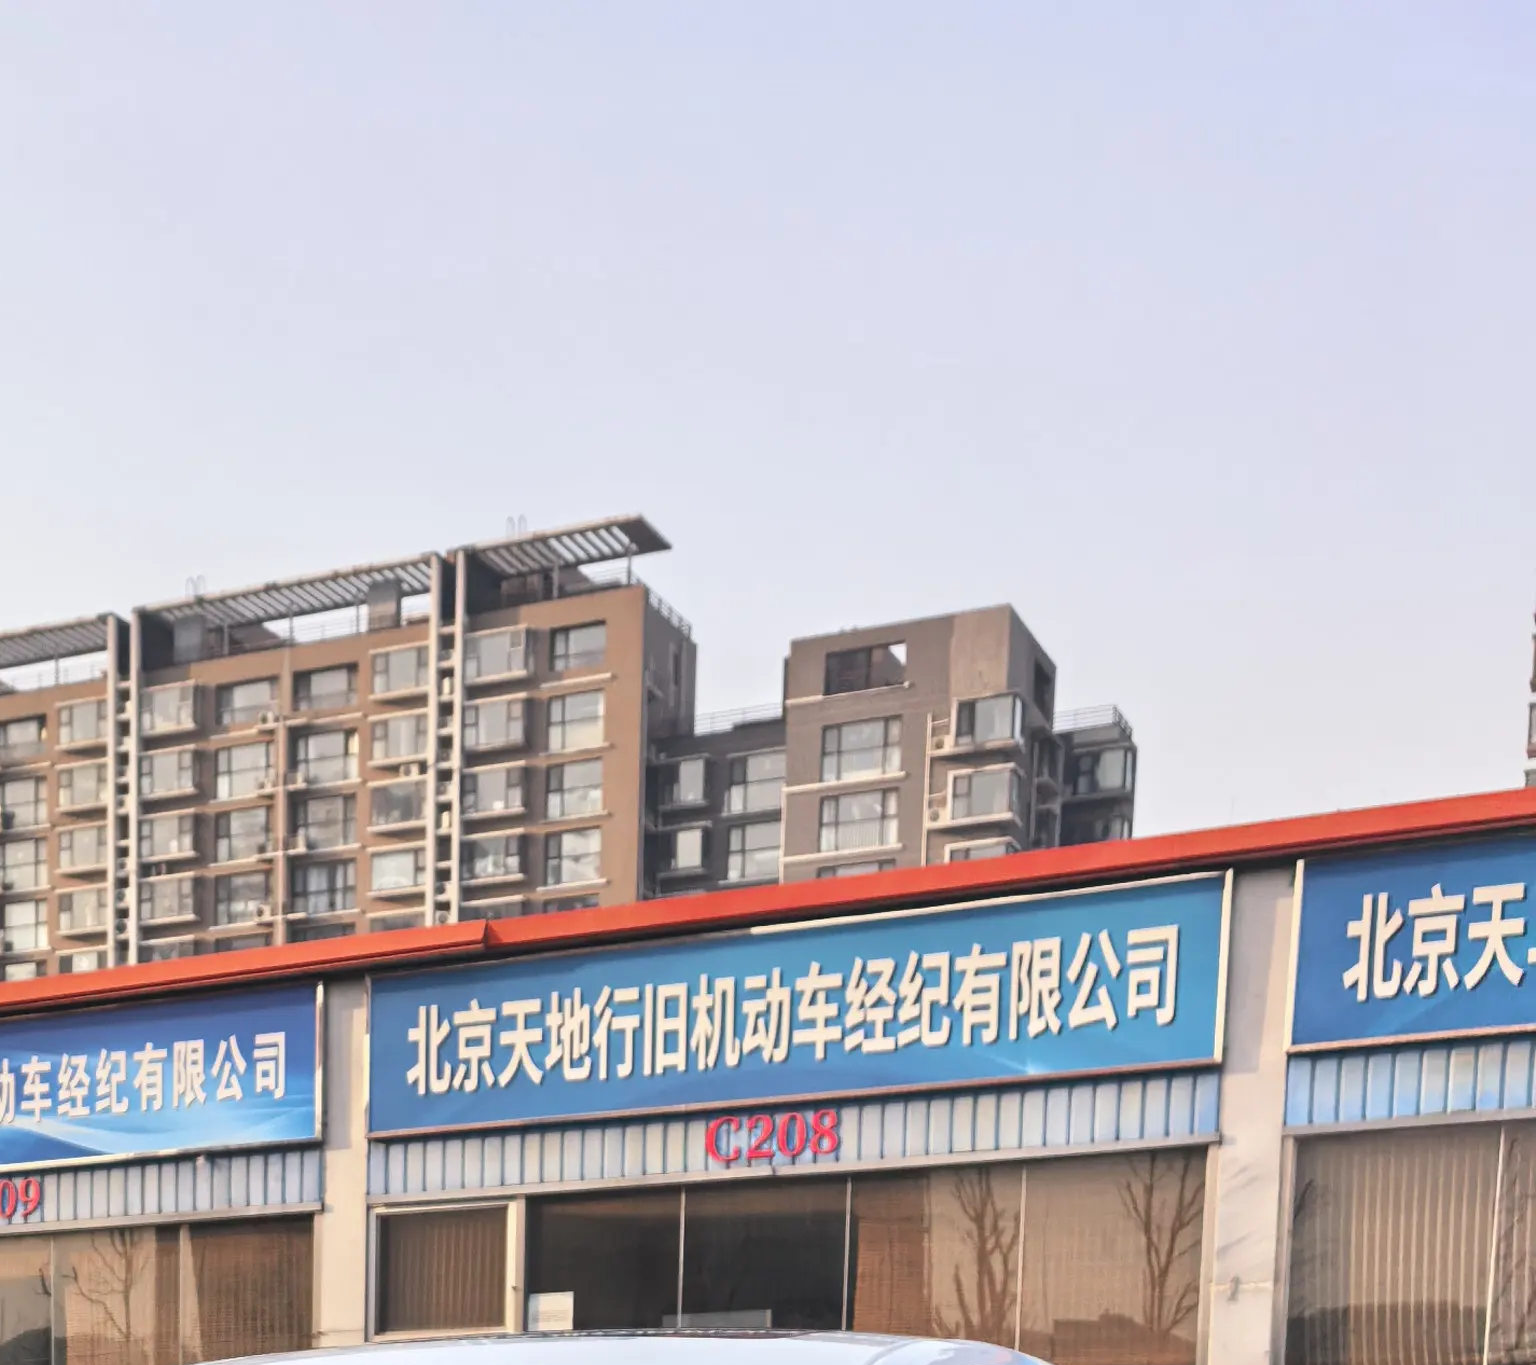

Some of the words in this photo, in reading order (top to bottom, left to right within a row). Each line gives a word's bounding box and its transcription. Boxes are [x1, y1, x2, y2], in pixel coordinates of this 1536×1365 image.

[1343, 882, 1536, 1003] 北京天
[405, 923, 1180, 1096] 北京天地行旧机动车经纪有限公司
[704, 1108, 841, 1165] C208
